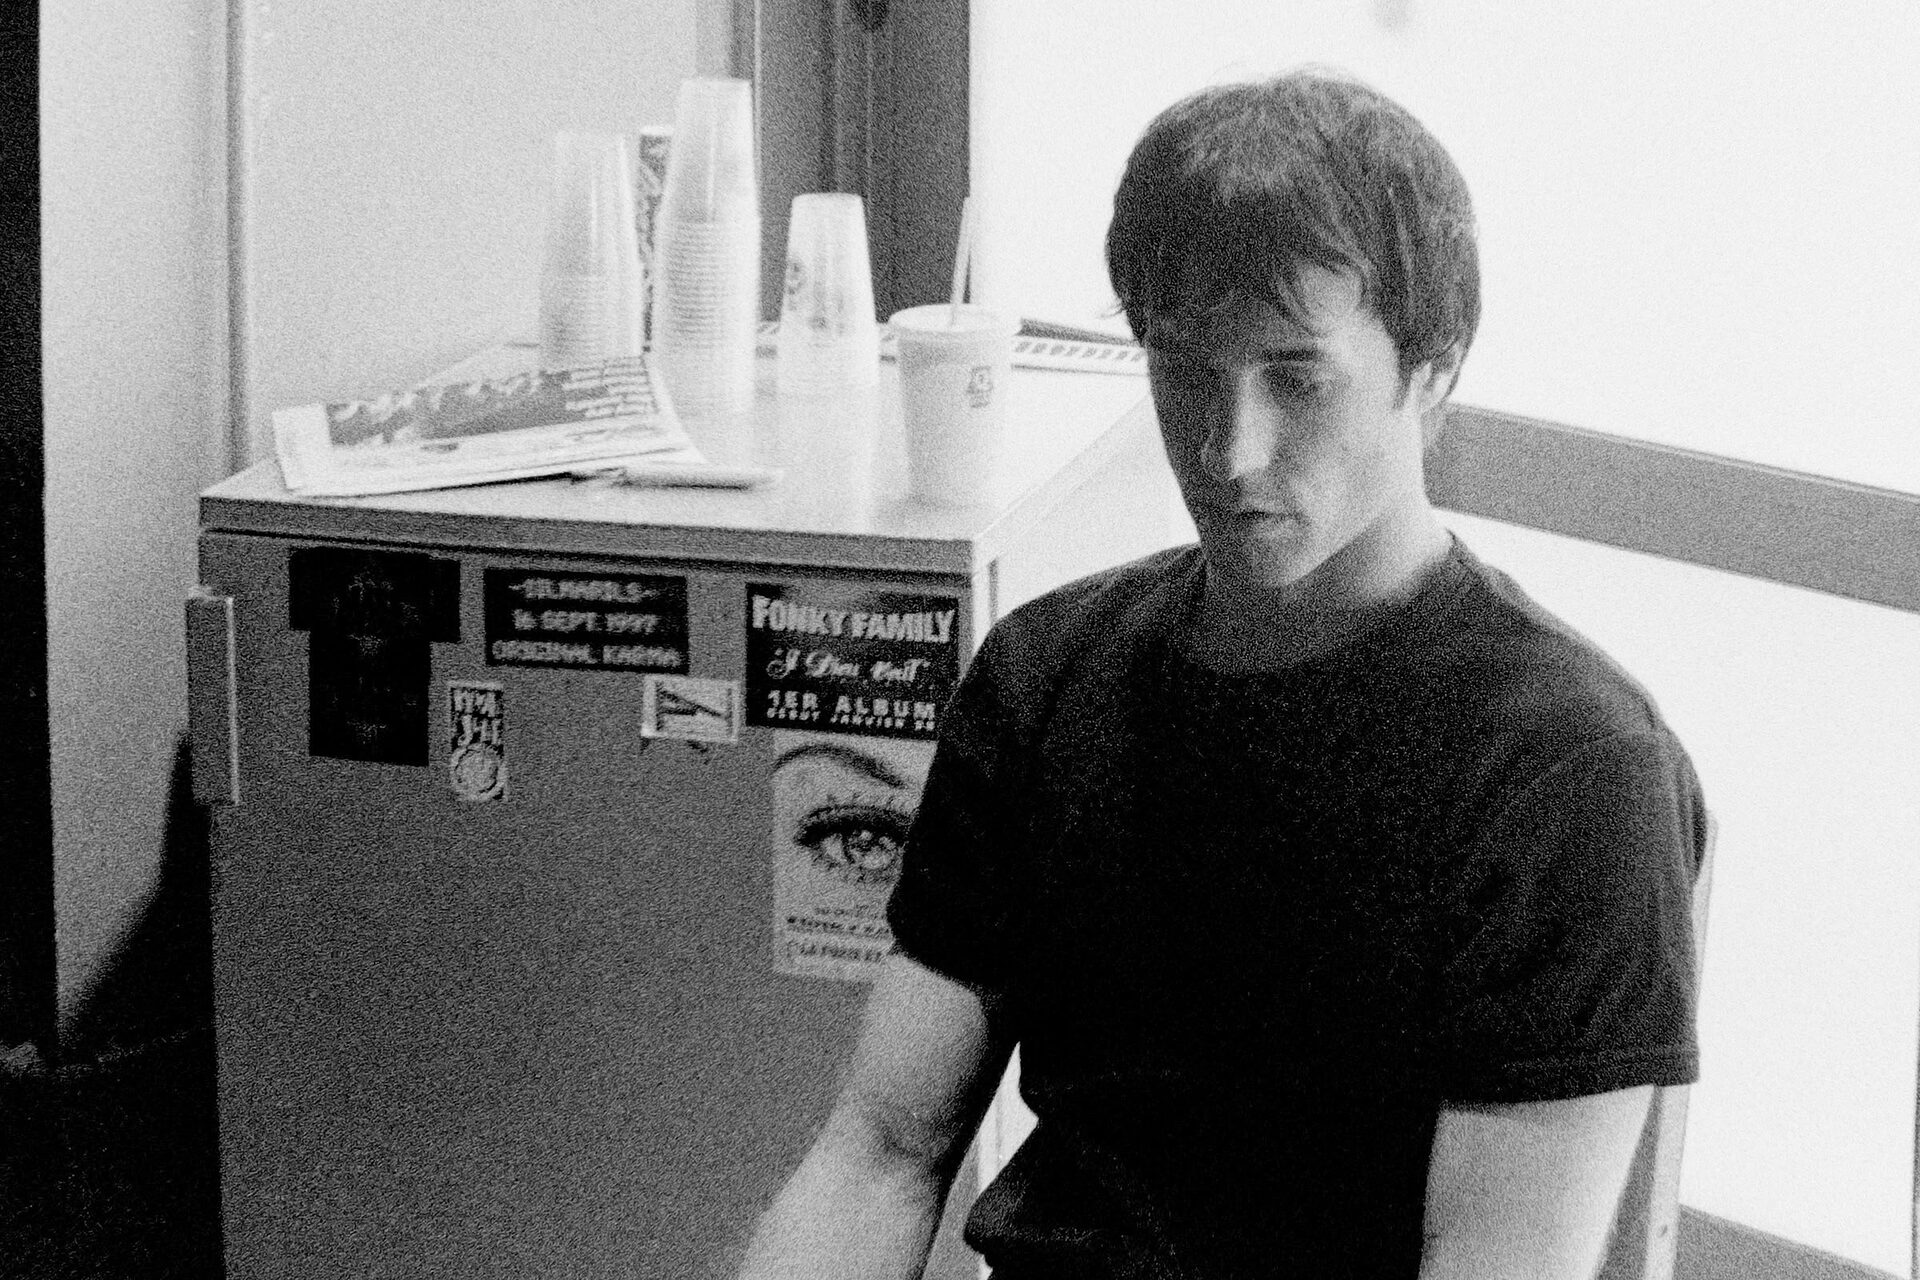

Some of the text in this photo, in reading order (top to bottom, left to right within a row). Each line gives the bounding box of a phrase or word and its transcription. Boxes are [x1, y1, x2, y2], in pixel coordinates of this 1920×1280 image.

[752, 594, 955, 643] FONKY FAMILY
[768, 690, 935, 718] 1ER ALBUM
